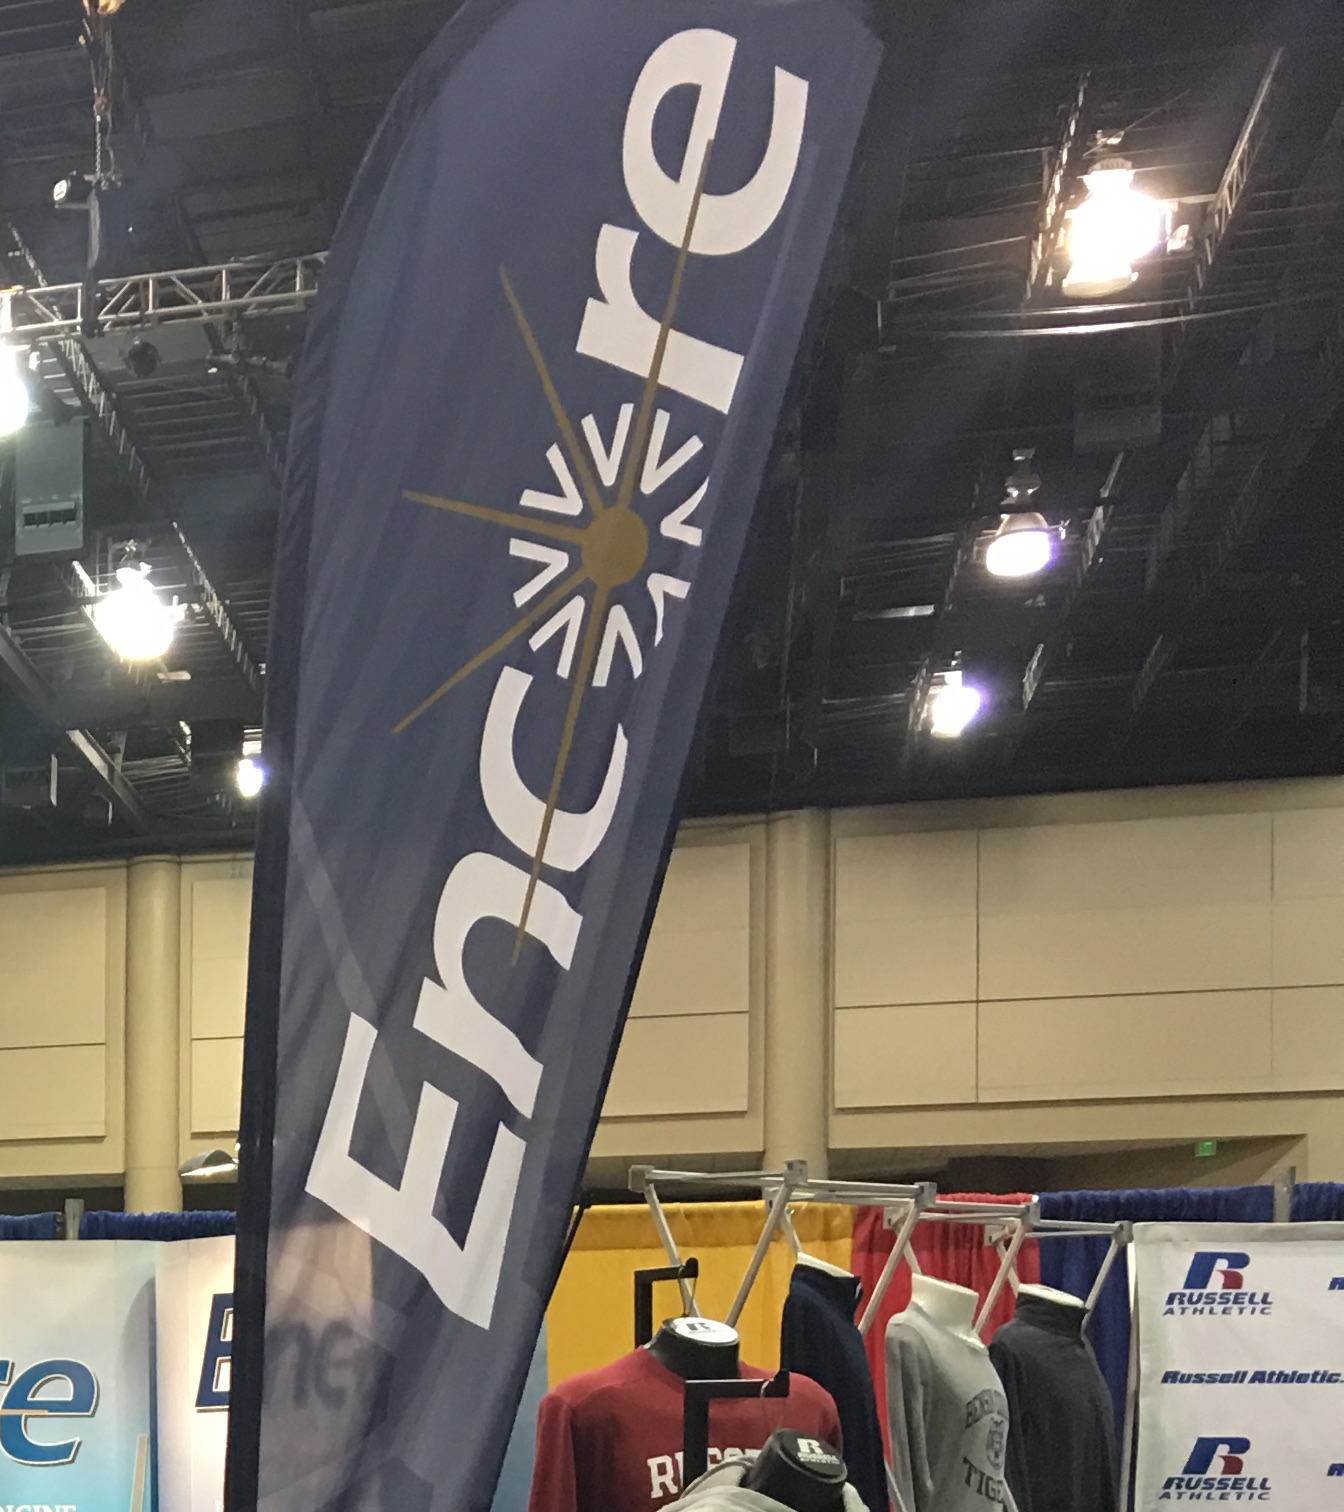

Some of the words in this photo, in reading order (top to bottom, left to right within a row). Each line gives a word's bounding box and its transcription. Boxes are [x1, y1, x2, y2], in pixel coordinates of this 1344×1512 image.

[1165, 1291, 1273, 1306] RUSSELL
[1162, 1306, 1272, 1316] ATHLETIC
[1161, 1370, 1248, 1384] Russell
[1162, 1476, 1272, 1491] RUSSELL
[1159, 1491, 1270, 1501] ATHLETIC
